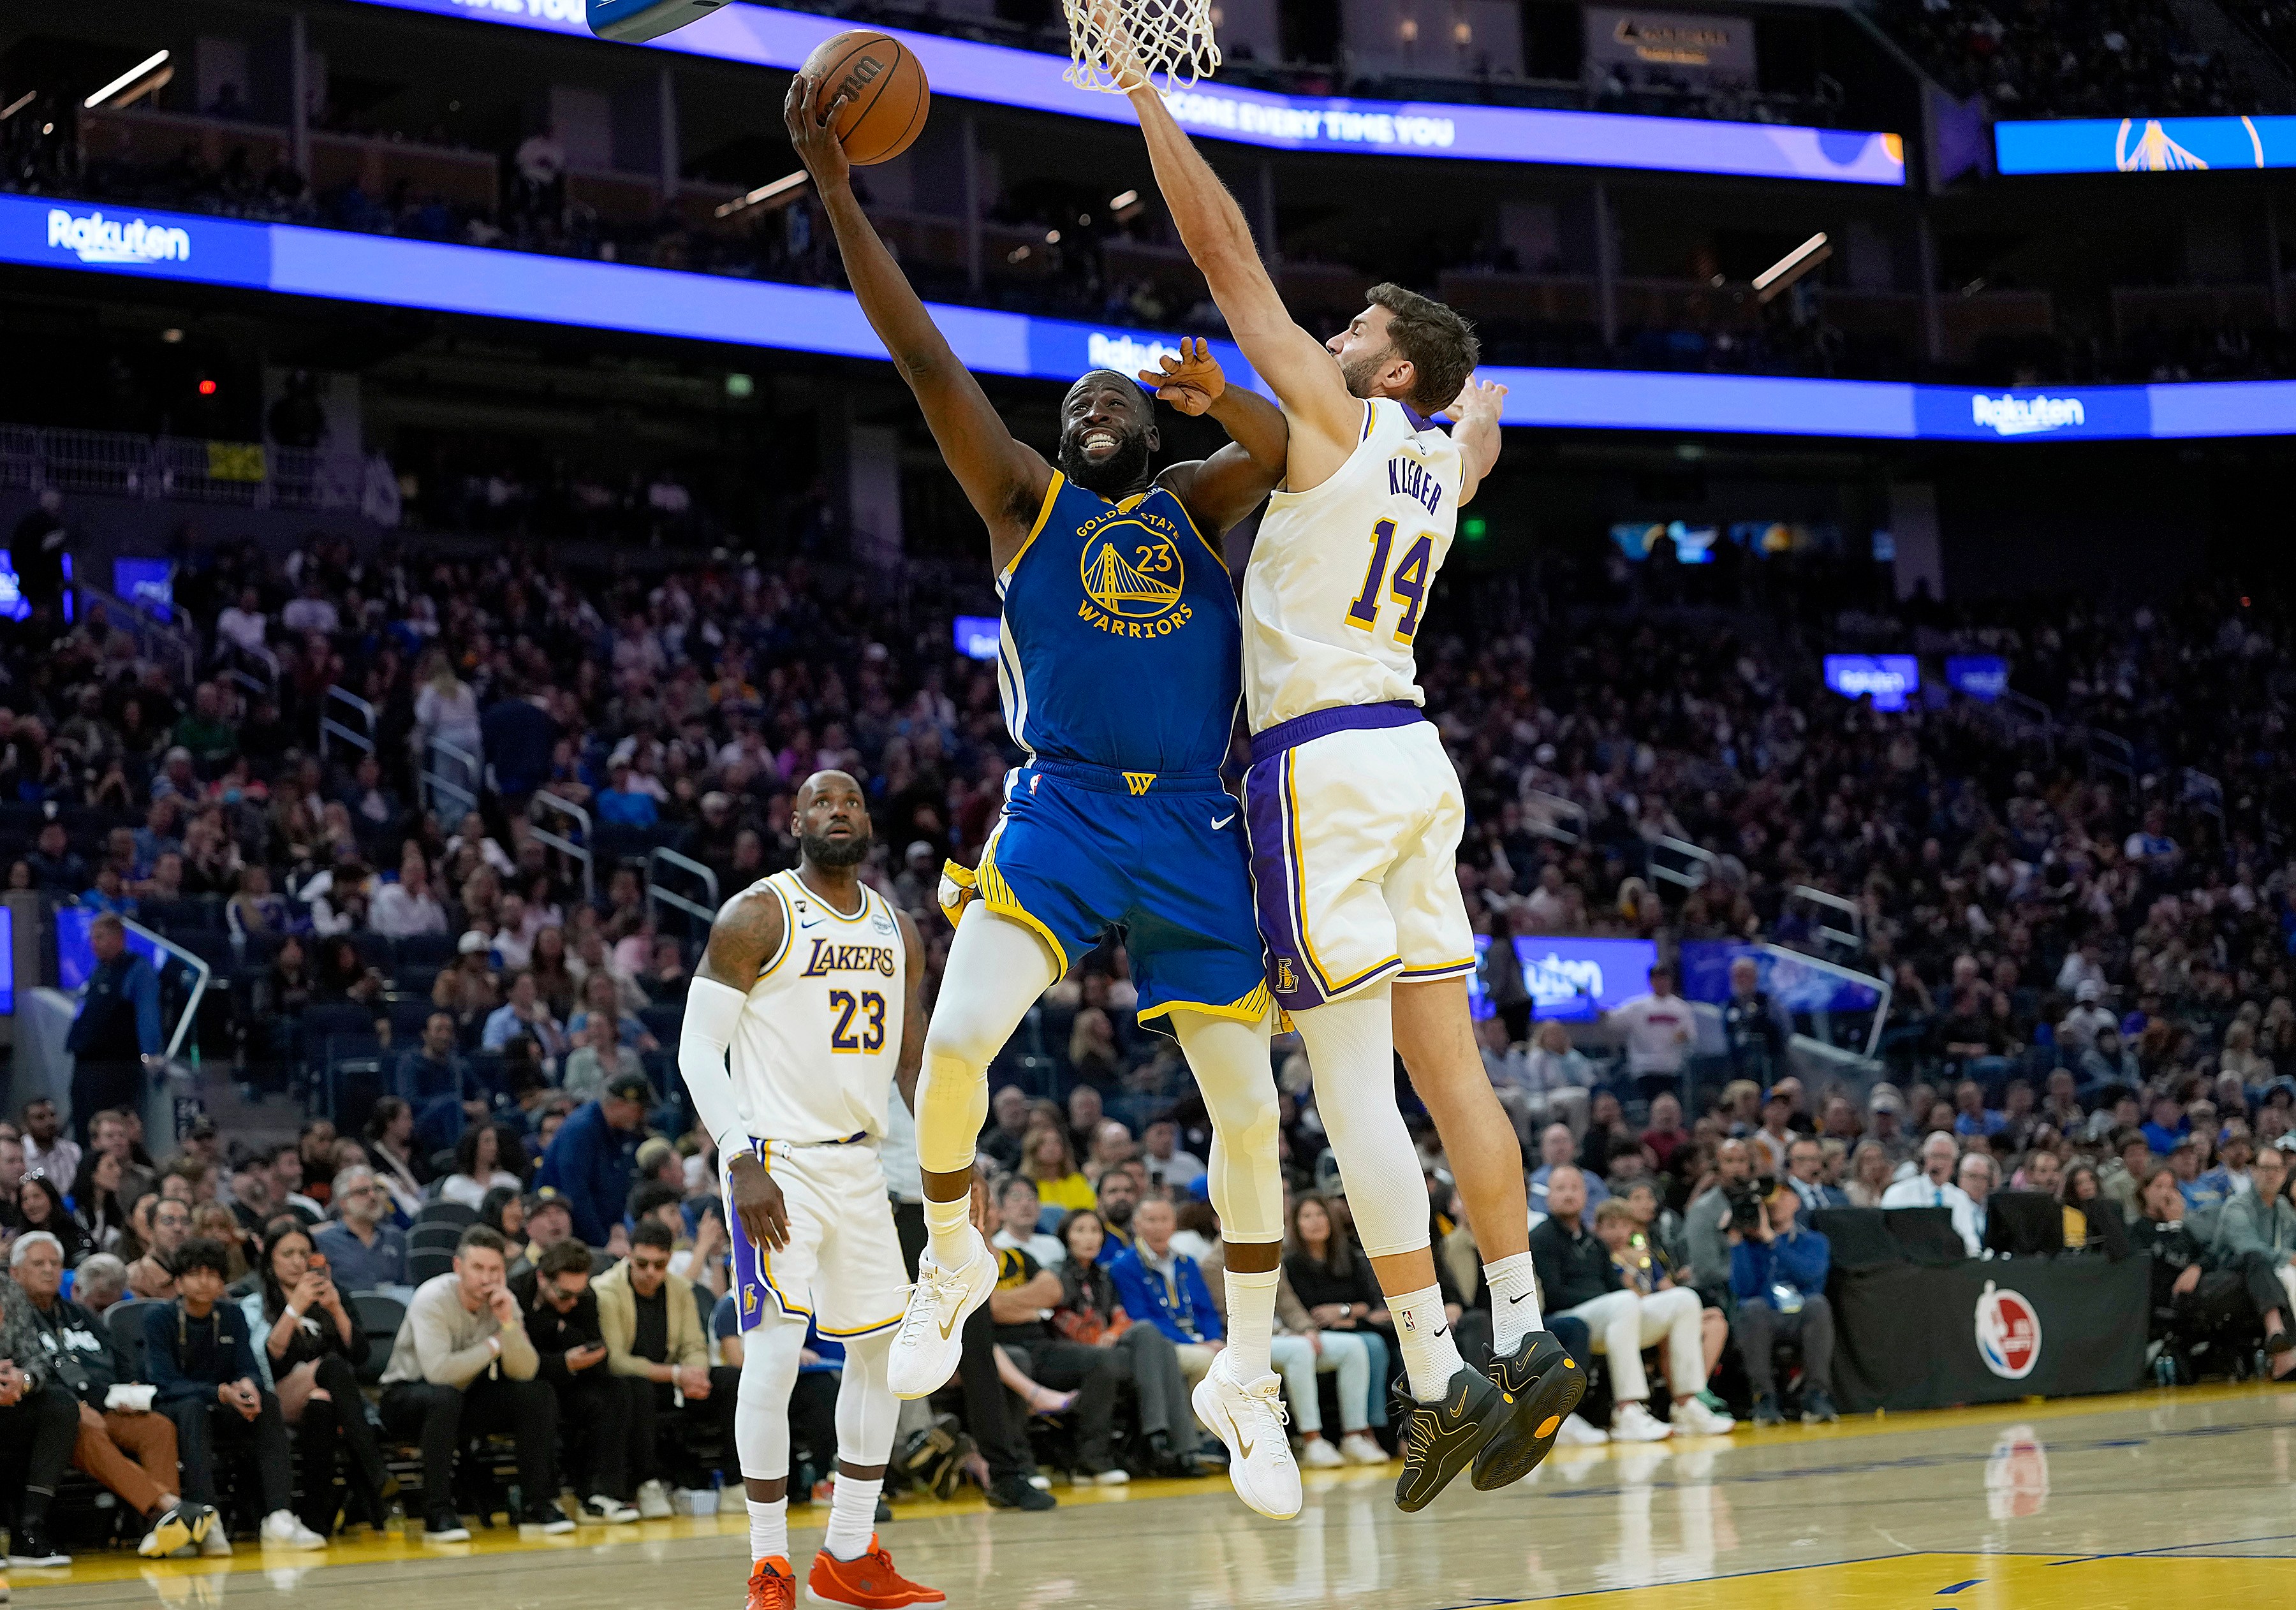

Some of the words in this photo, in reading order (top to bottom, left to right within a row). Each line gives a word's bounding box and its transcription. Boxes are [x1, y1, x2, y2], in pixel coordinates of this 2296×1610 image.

[47, 209, 190, 263] Rakuten
[1972, 394, 2085, 429] Rakuten
[1388, 457, 1442, 516] KLEBER
[1076, 509, 1128, 537] GOLDE
[1135, 543, 1172, 572] 23
[1344, 516, 1434, 647] 14
[1077, 599, 1193, 638] WARRIORS
[799, 937, 895, 978] LAKERS
[829, 988, 886, 1055] 23
